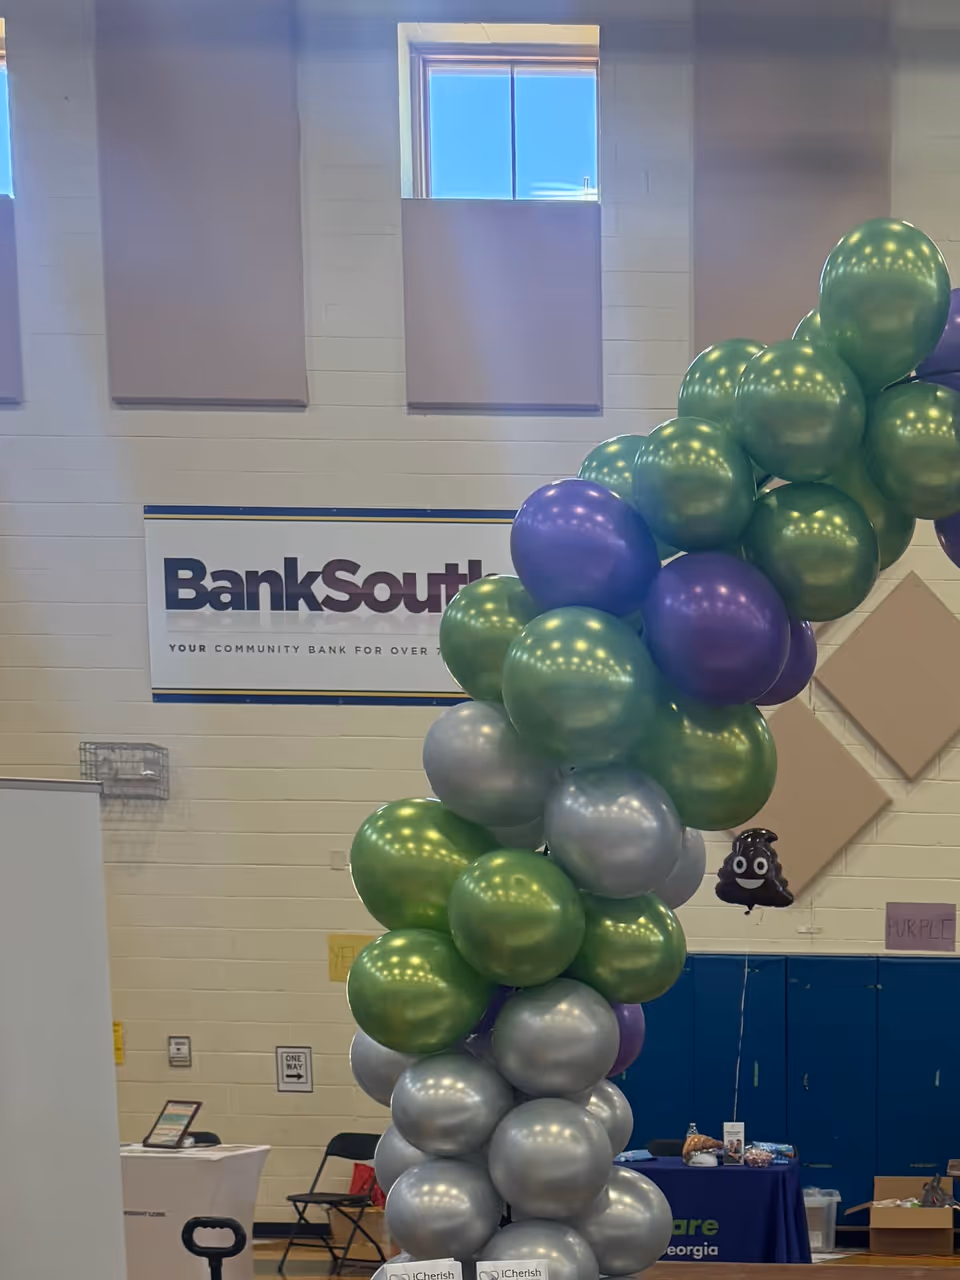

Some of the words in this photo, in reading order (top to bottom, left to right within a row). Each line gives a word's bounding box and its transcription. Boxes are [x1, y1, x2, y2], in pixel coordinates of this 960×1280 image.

[164, 557, 500, 613] BankSout
[169, 644, 206, 652] YOUR
[214, 644, 300, 654] COMMUNITY
[308, 646, 346, 655] BANK
[355, 646, 382, 655] FOR
[390, 646, 428, 655] OVER
[672, 1219, 718, 1235] are
[667, 1242, 718, 1259] eorgia
[413, 1271, 454, 1280] iCherish
[502, 1269, 542, 1278] iCherish
